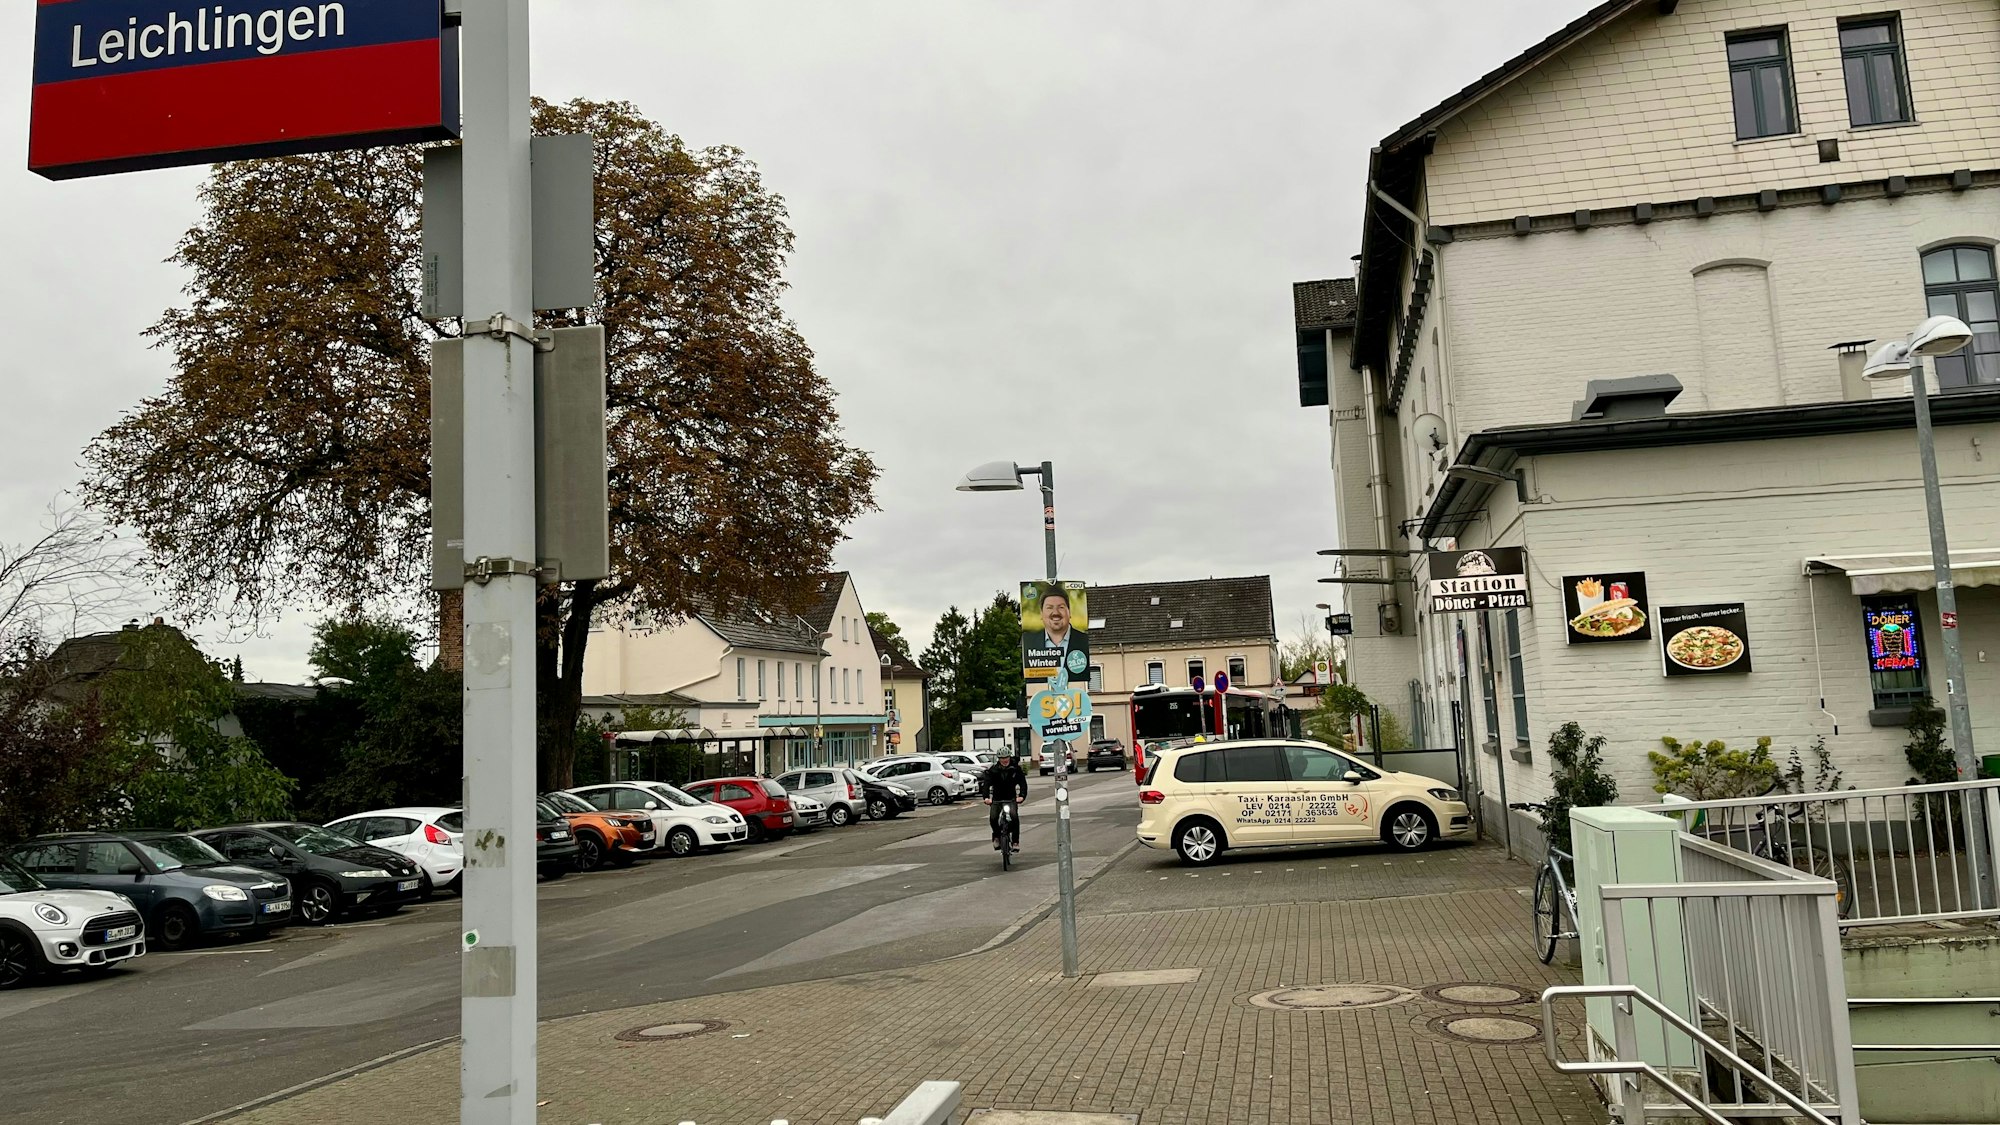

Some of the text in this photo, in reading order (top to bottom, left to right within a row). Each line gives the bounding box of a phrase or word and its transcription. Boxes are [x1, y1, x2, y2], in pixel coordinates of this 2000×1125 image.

[71, 2, 345, 68] Leichlingen
[1440, 577, 1516, 594] Station
[1434, 595, 1477, 611] Döner
[1487, 593, 1526, 608] Pizza
[1662, 615, 1681, 624] Immer
[1701, 610, 1720, 618] immer
[1027, 648, 1062, 657] Maurice
[1028, 659, 1058, 667] Winter
[1876, 657, 1916, 668] KEBAB
[1169, 702, 1178, 710] 255
[1045, 724, 1078, 735] vorwärts
[1237, 795, 1258, 803] Taxi
[1267, 794, 1317, 802] Karaaslan
[1319, 794, 1349, 802] GmbH
[1268, 802, 1291, 810] 0214
[1236, 817, 1271, 825] WhatsApp
